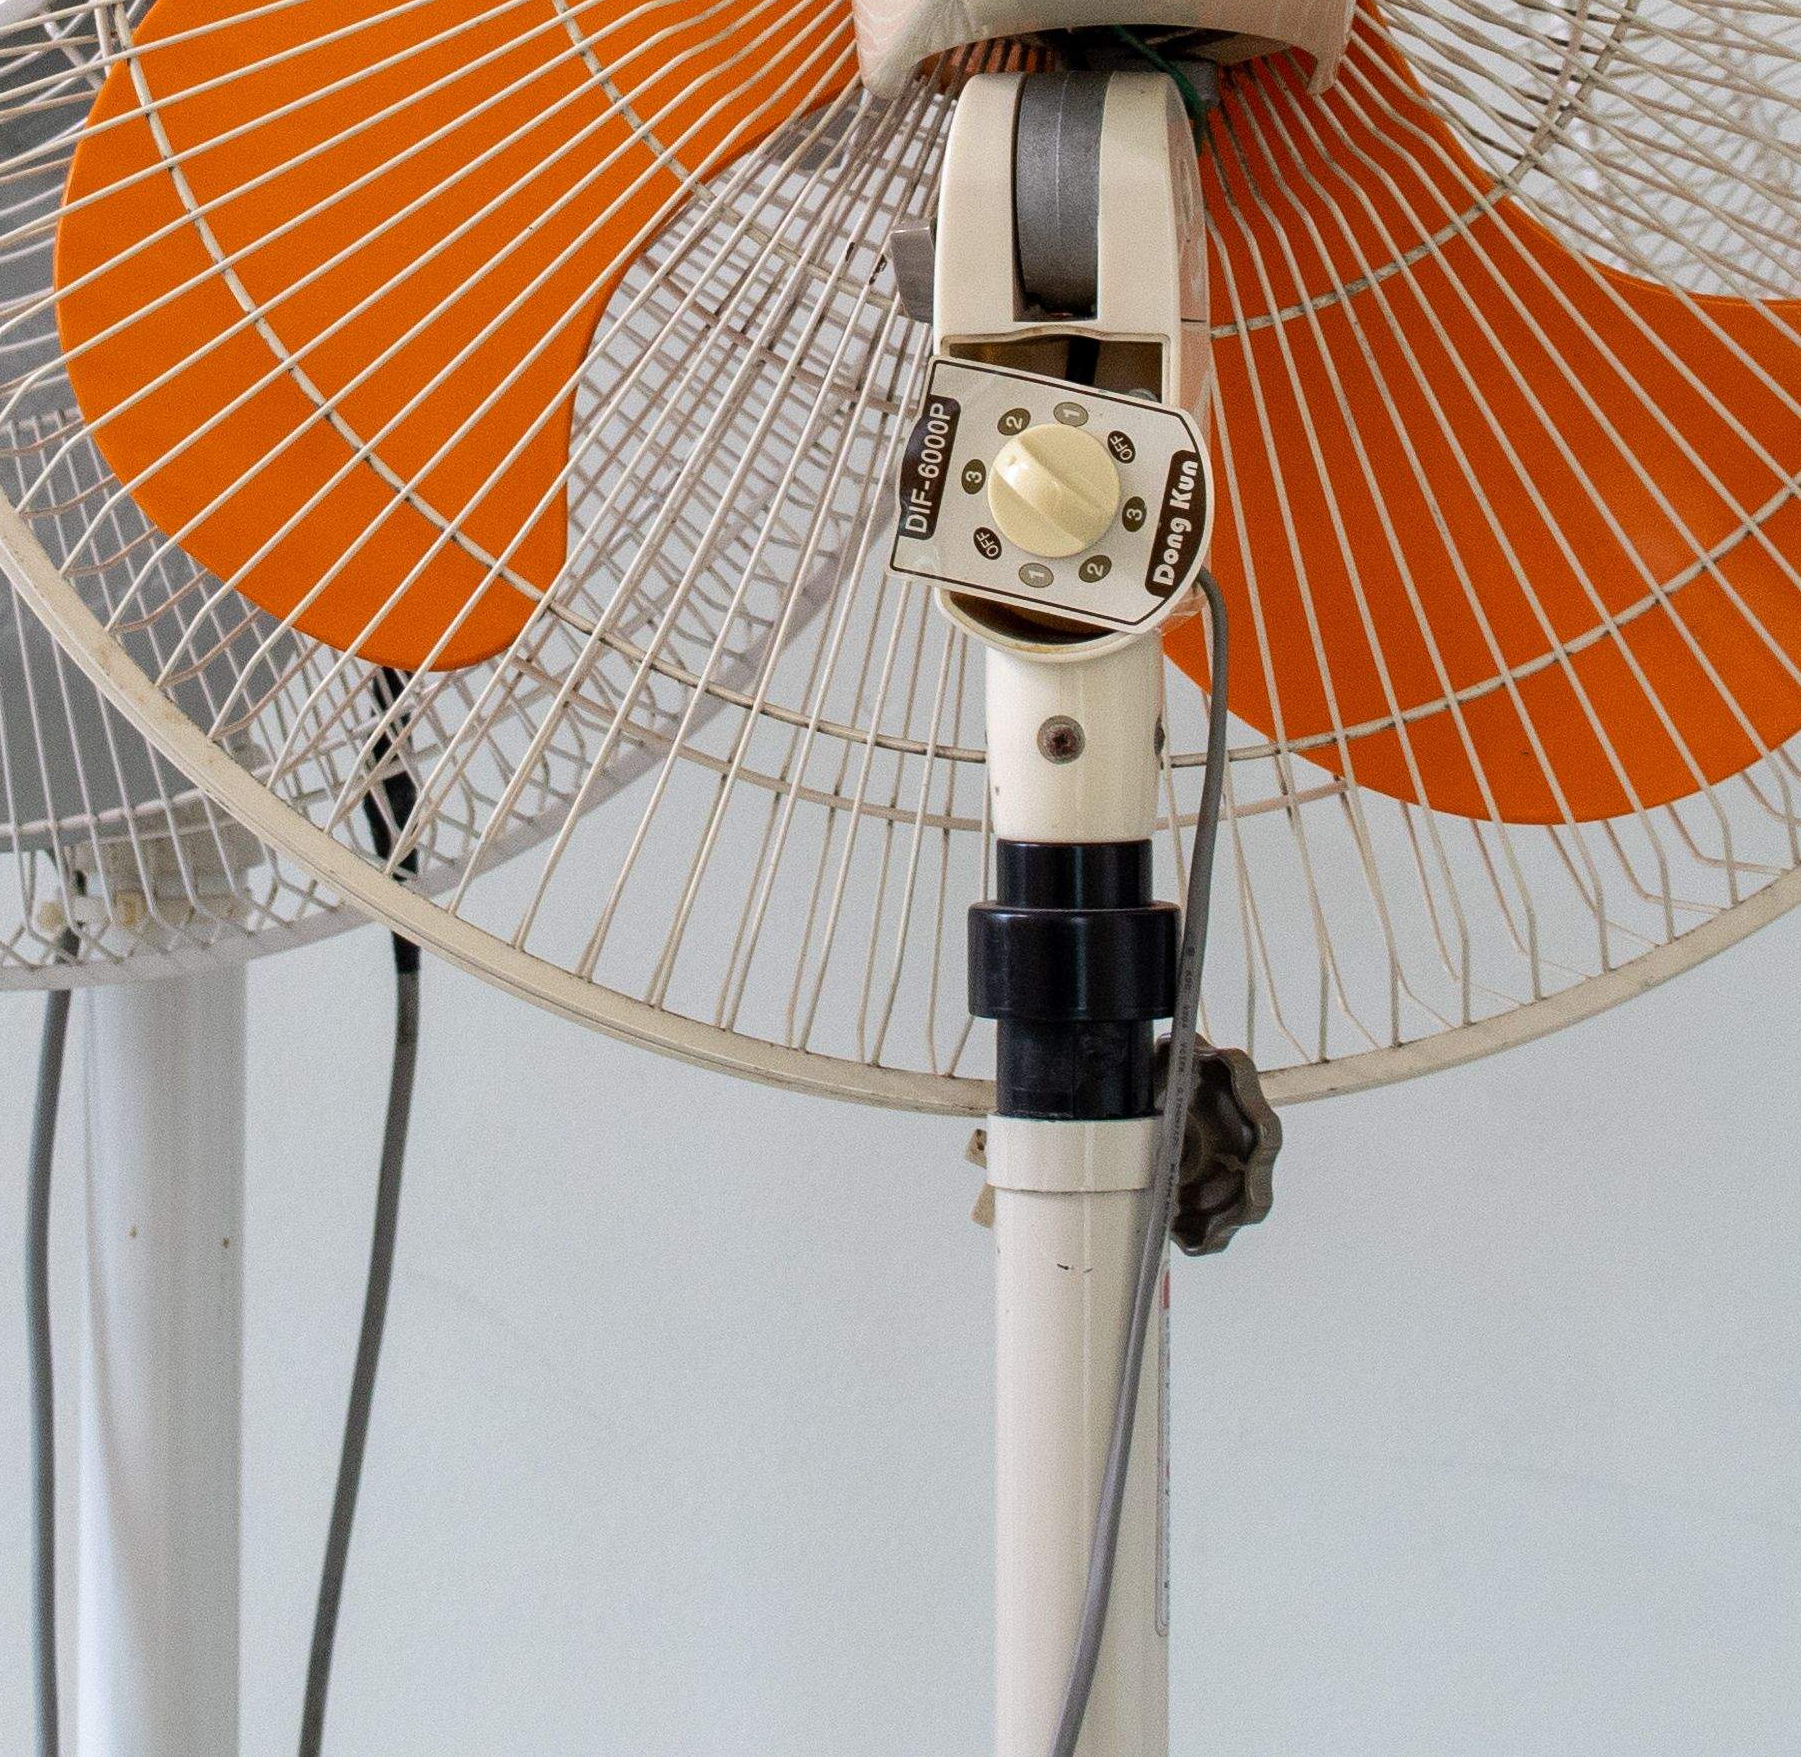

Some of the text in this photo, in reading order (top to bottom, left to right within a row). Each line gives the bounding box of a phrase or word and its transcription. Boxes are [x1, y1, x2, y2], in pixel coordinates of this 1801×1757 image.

[1062, 407, 1079, 419] 1
[1005, 414, 1023, 431] 2
[1109, 434, 1134, 461] OFF
[904, 401, 952, 536] DIF-6000P
[965, 470, 983, 484] 3
[1126, 507, 1143, 522] 3
[1151, 460, 1199, 587] Dong Kun
[975, 532, 999, 558] OFF
[1028, 569, 1045, 581] 1
[1087, 562, 1105, 576] 2
